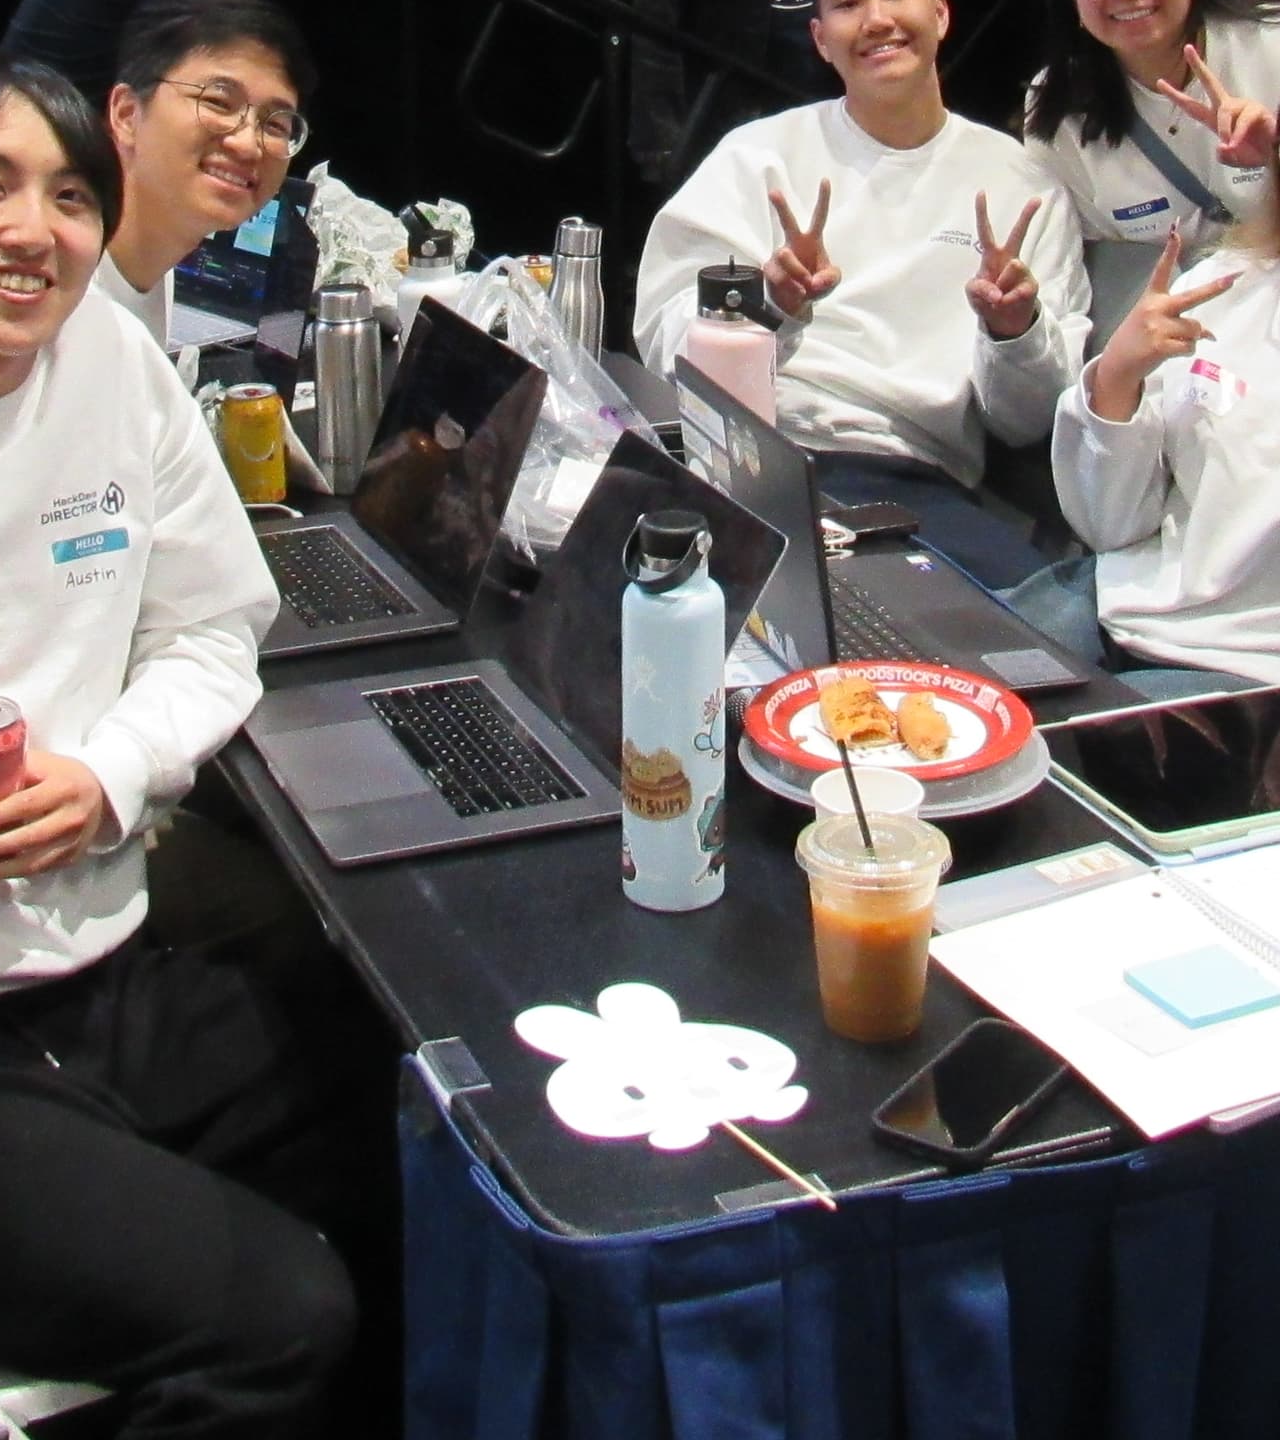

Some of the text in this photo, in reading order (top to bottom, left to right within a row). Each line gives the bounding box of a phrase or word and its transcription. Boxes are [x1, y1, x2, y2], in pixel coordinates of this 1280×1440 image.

[40, 501, 98, 525] DIRECTOR
[75, 534, 105, 550] HELLO
[65, 567, 118, 589] Austin
[844, 666, 975, 696] WOODSTOCK'S PIZZA
[646, 797, 684, 815] SUM
